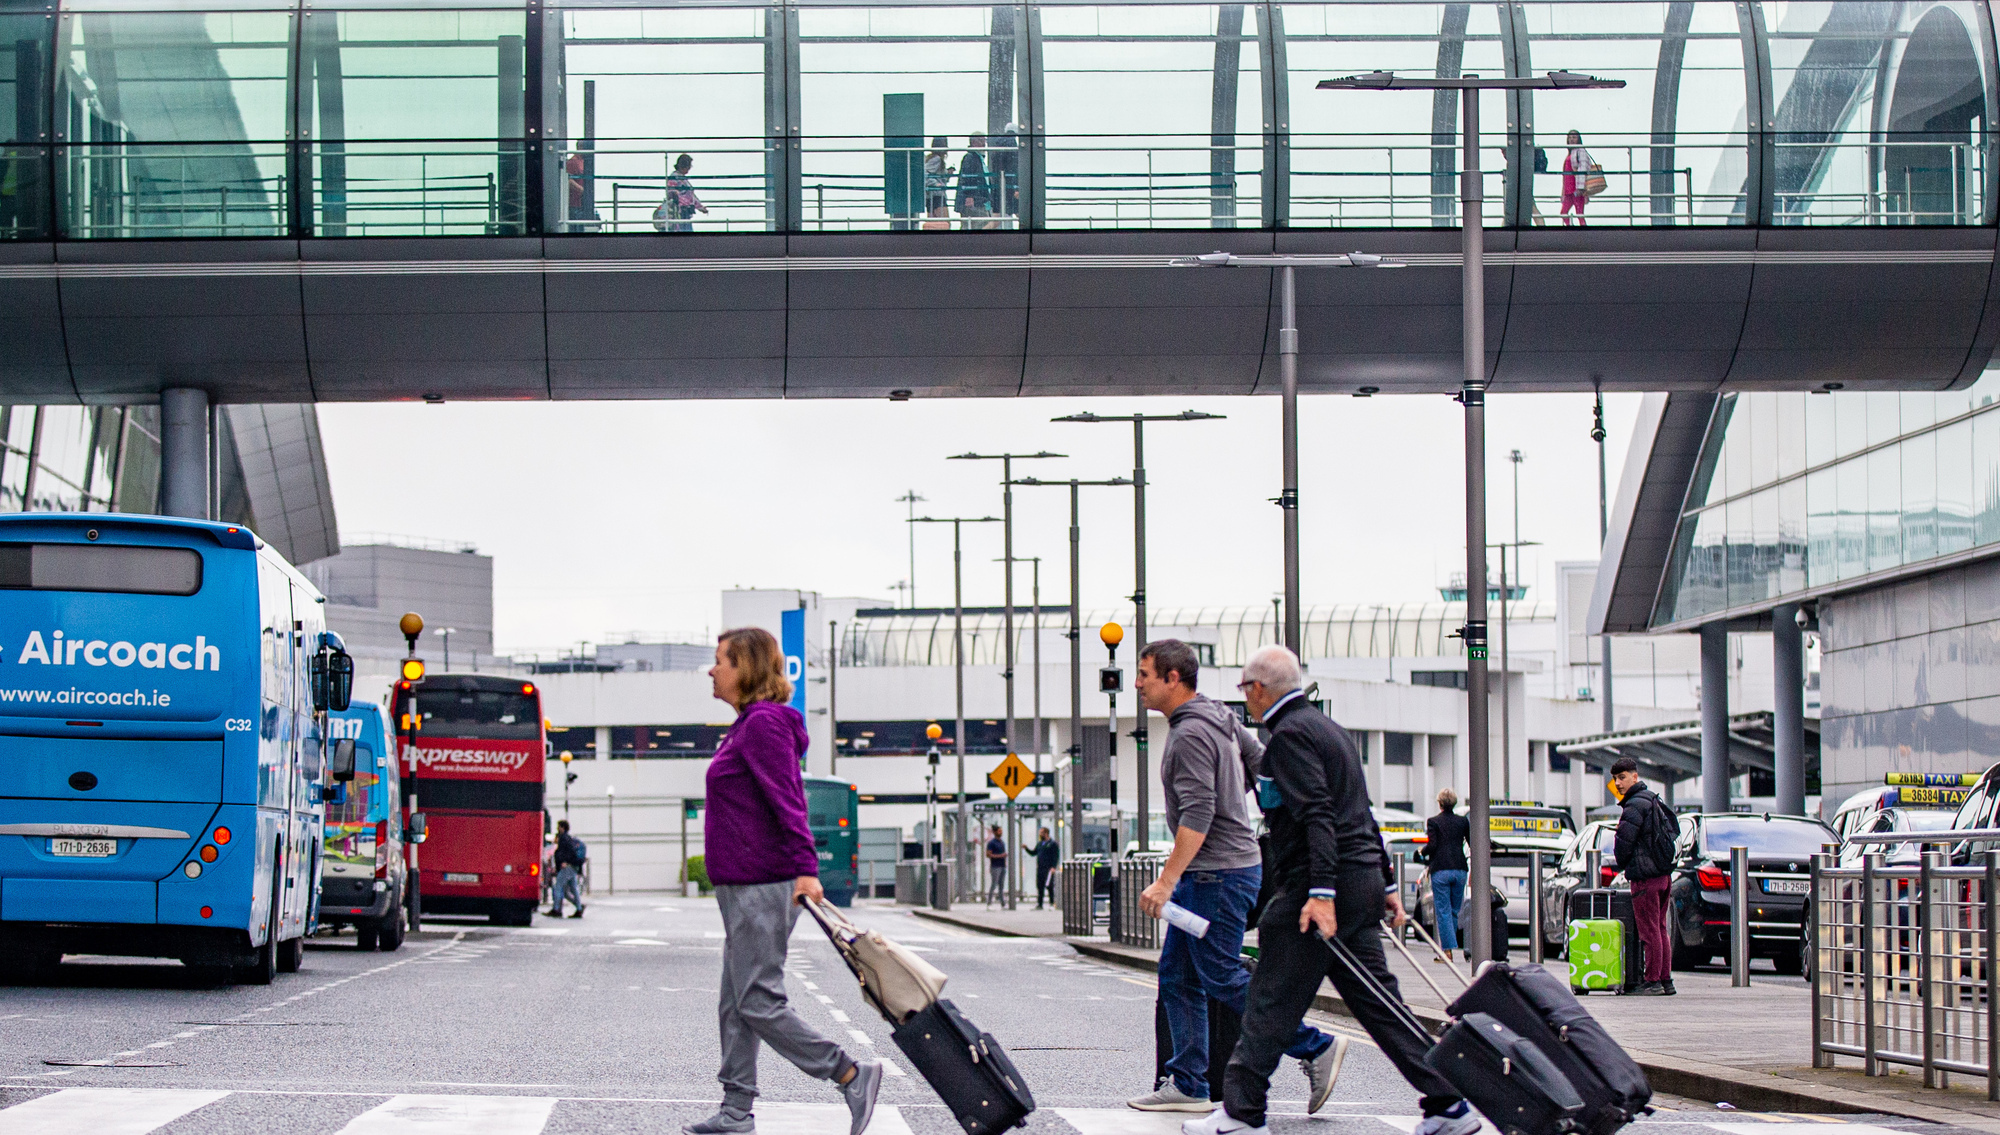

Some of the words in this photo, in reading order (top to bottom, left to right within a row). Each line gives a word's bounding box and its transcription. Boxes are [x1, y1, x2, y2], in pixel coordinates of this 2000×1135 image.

[18, 629, 220, 671] Aircoach
[1472, 650, 1486, 658] 121
[0, 686, 171, 707] www.aircoach.ie
[225, 718, 252, 732] C32
[1927, 774, 1956, 785] TAXI
[1911, 789, 1938, 802] 36384
[1941, 790, 1968, 803] TAX
[53, 825, 109, 835] PLAXTON
[1514, 819, 1536, 829] TAXI
[59, 841, 110, 853] 171-D-2636
